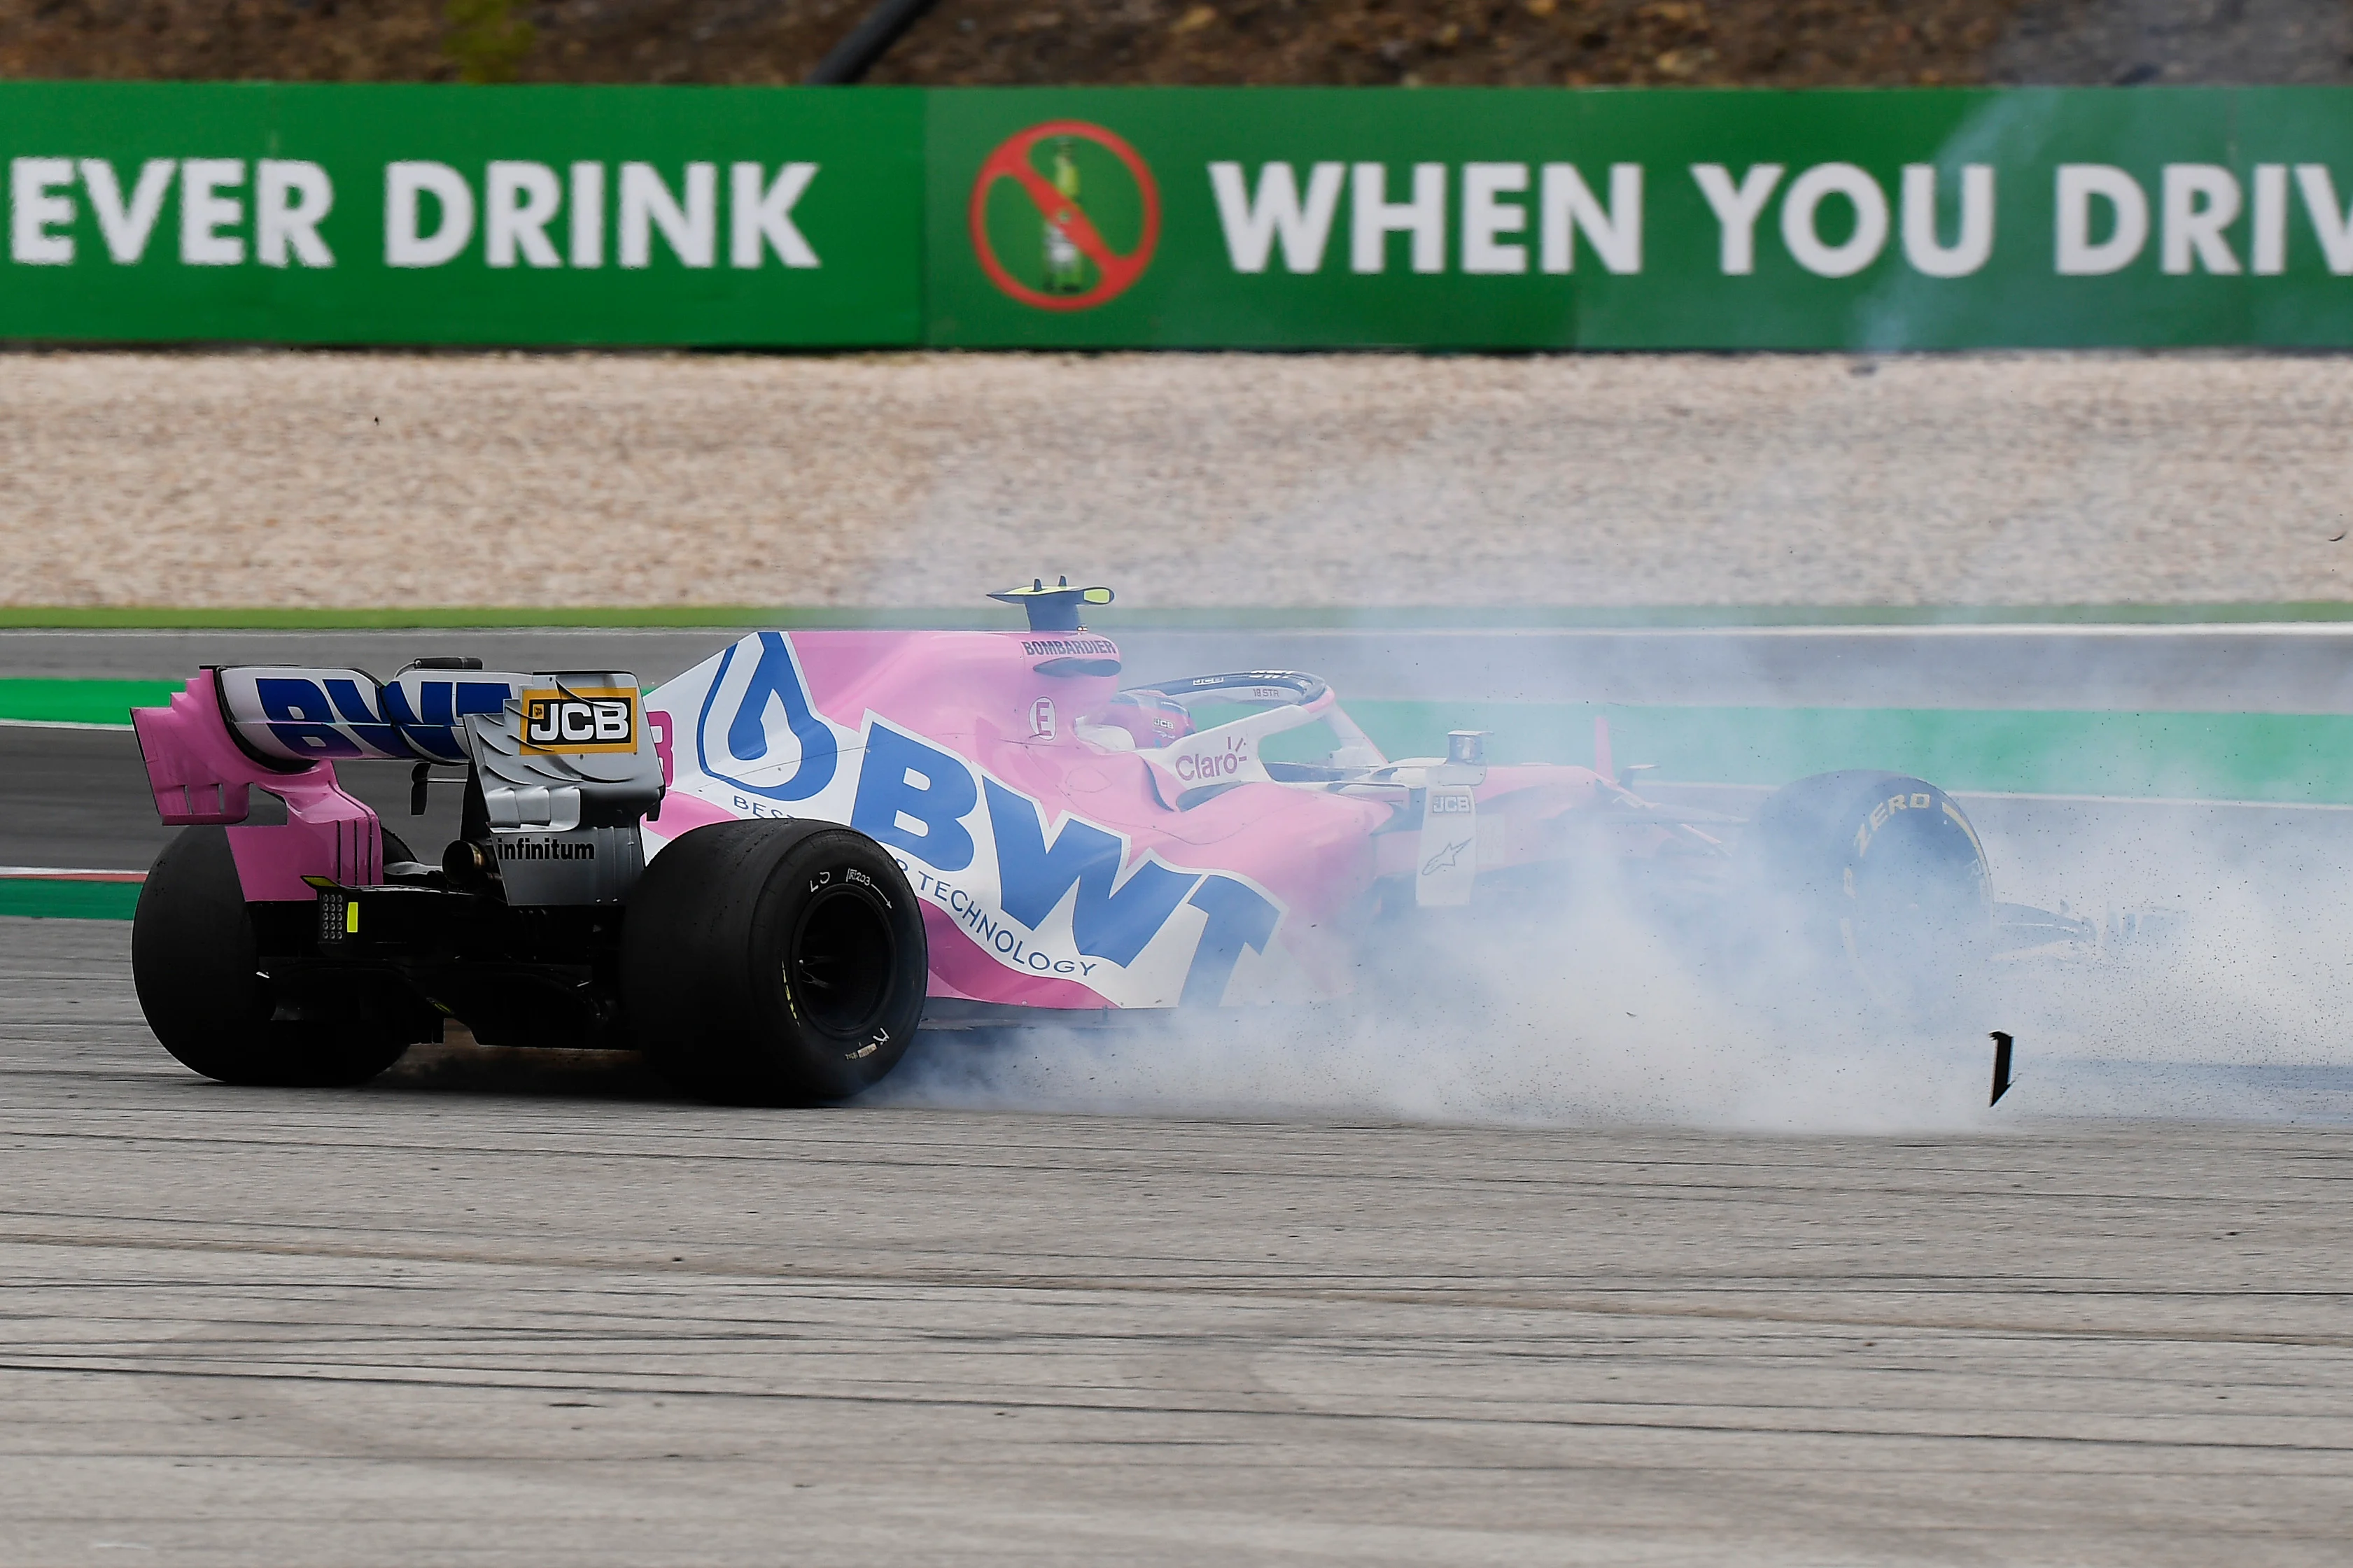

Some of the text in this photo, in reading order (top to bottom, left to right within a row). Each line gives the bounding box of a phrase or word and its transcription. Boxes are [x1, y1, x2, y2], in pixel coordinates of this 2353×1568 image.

[13, 158, 817, 267] EVER DRINK
[1211, 163, 1641, 273] WHEN
[1694, 164, 1993, 276] YOU
[1021, 640, 1118, 656] BOMBARDIER
[255, 677, 513, 759] BWT
[531, 701, 629, 741] JCB
[1036, 702, 1052, 736] E
[1154, 718, 1174, 729] JCB
[1175, 752, 1238, 781] Claro
[1433, 796, 1470, 813] JCB
[1854, 793, 1930, 858] ZERO
[497, 838, 596, 861] infinitum
[850, 720, 1281, 1010] BWT
[733, 795, 1097, 977] BES TECHNOLOGY
